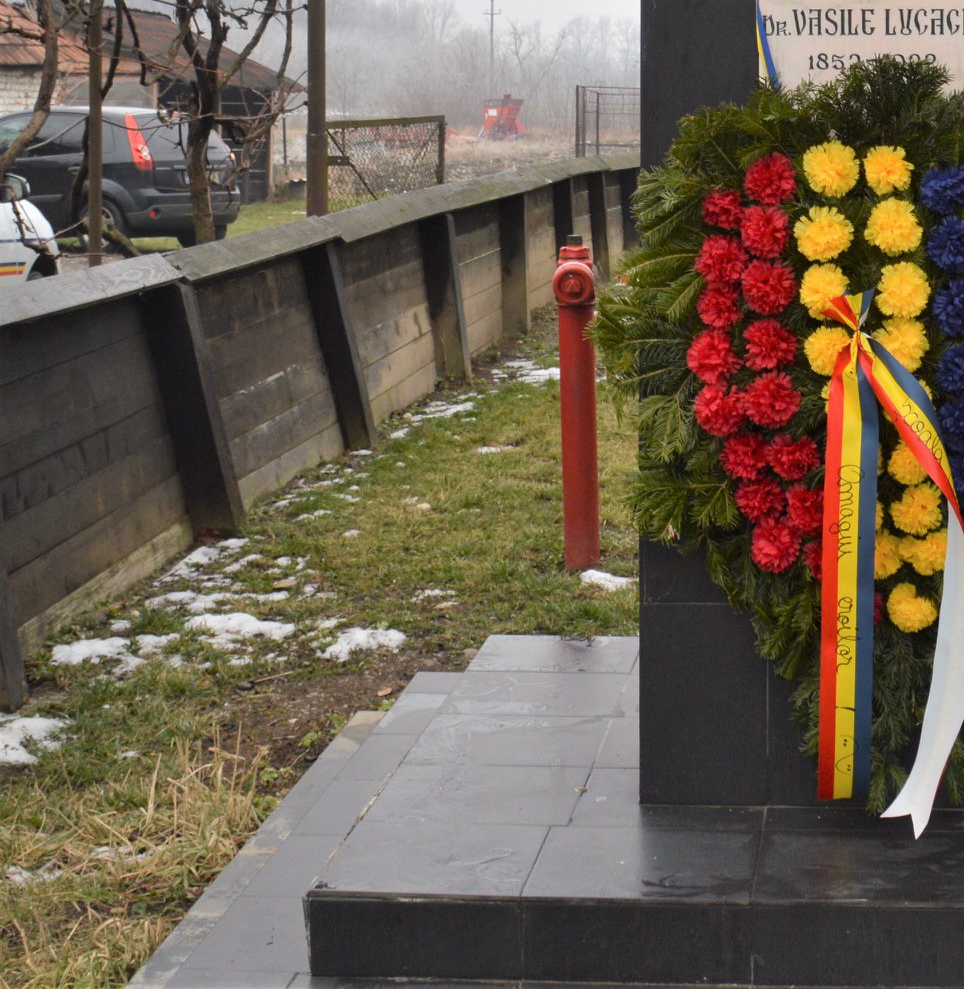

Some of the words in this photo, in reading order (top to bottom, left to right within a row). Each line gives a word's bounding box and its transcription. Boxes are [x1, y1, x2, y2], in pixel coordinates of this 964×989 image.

[792, 8, 876, 36] VASILE
[808, 53, 936, 70] 185-2
[829, 464, 865, 562] Omagiu
[836, 596, 861, 673] eroilor
